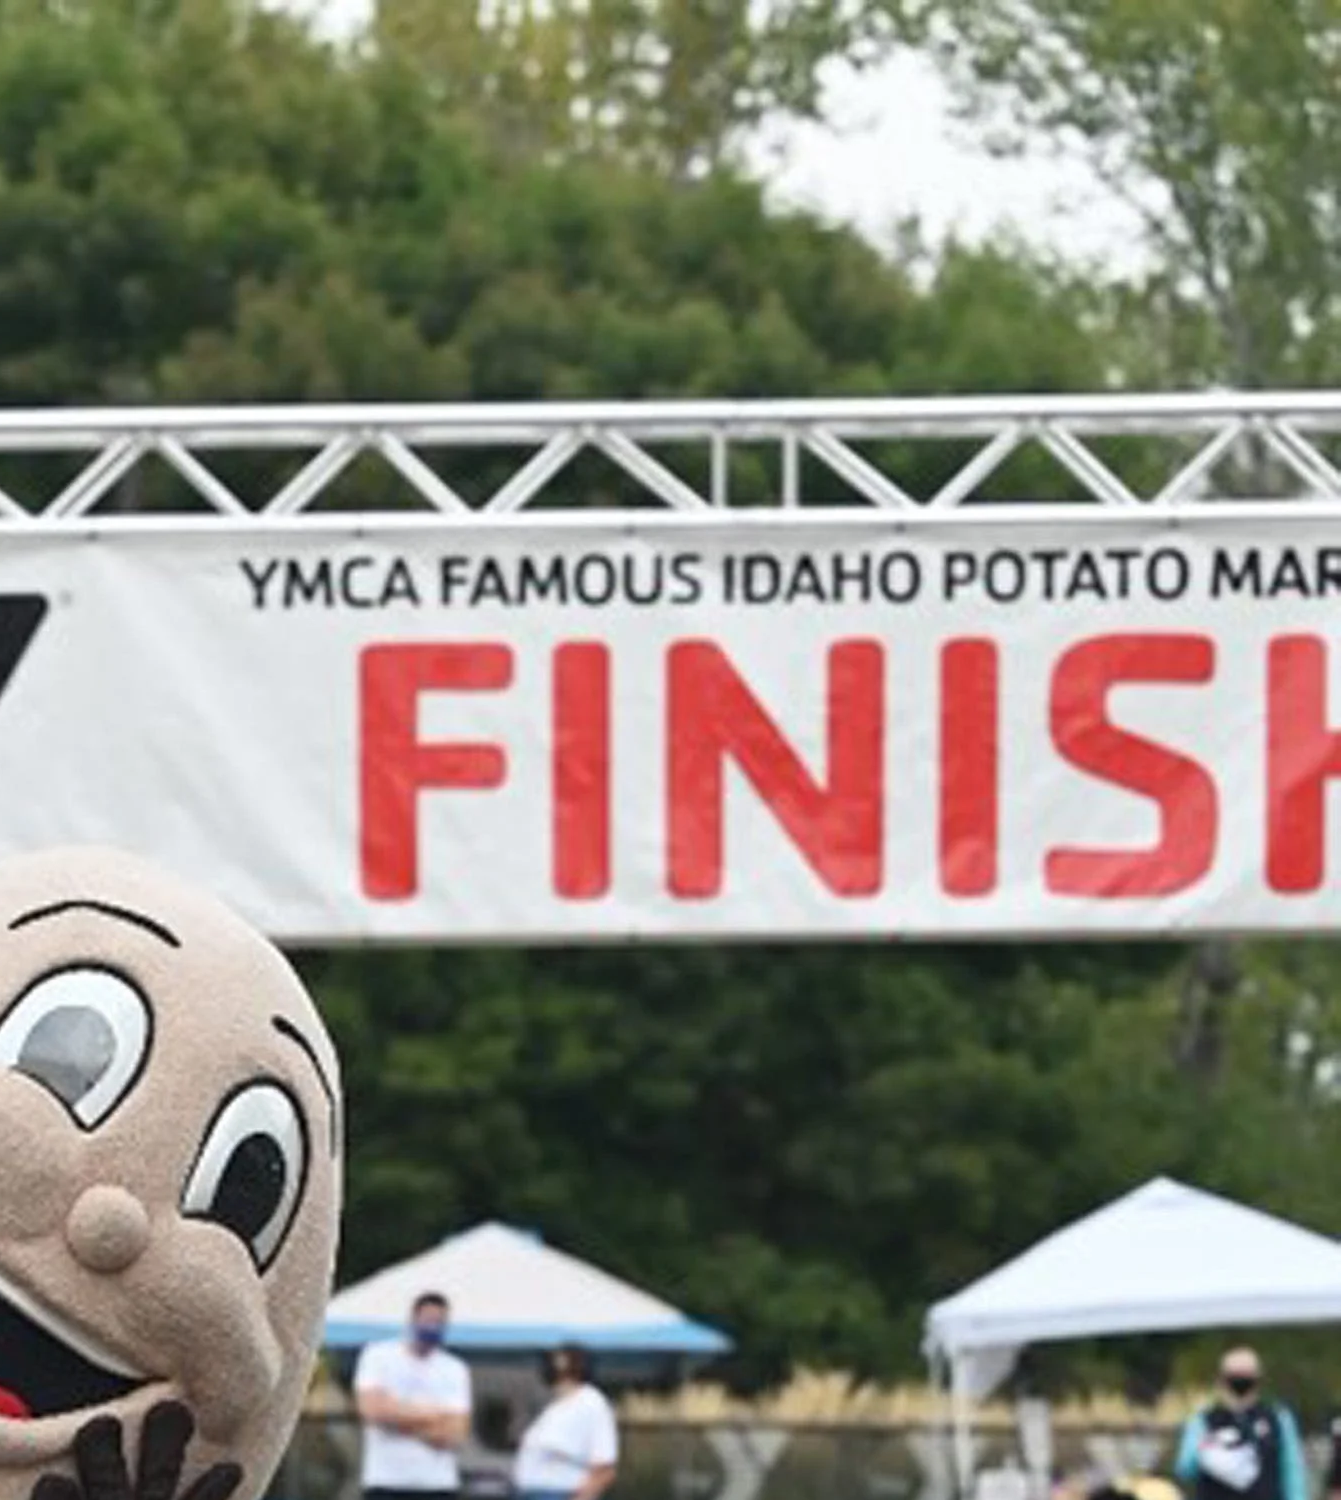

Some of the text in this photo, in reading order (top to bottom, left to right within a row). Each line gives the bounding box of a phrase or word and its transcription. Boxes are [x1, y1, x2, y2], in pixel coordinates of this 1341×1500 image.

[239, 556, 420, 609] YMCA
[438, 552, 704, 607] FAMOUS
[721, 550, 922, 605] IDAHO
[942, 546, 1189, 602] POTATO
